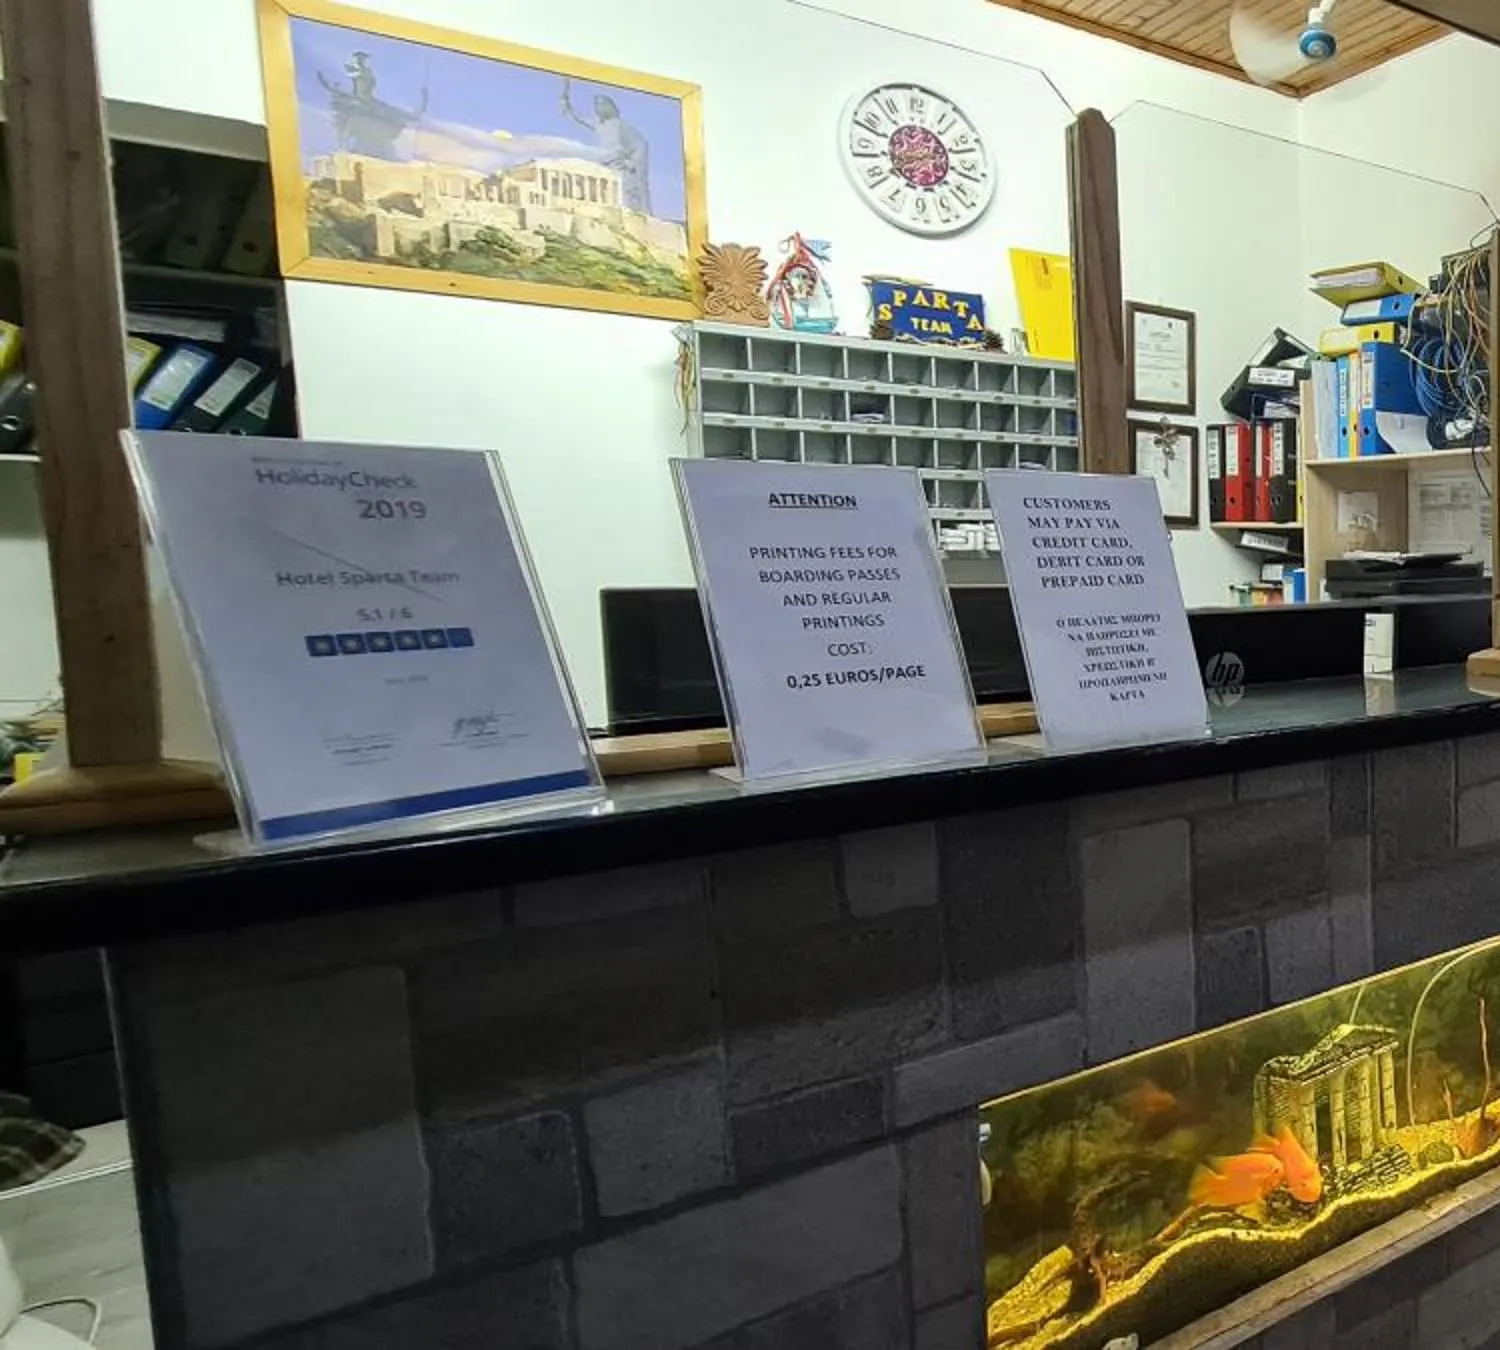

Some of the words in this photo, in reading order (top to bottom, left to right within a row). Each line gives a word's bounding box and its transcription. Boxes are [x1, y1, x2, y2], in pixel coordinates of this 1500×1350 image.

[877, 288, 984, 331] SPARTA
[909, 316, 953, 335] TEAM
[254, 468, 418, 492] HolidayCheck
[768, 492, 859, 509] ATTENTION
[1023, 497, 1112, 511] CUSTOMERS
[355, 499, 428, 520] 2019
[1027, 515, 1061, 529] MAY
[1064, 516, 1092, 529] PAY
[1095, 517, 1121, 529] VIA
[1031, 536, 1087, 549] CREDIT
[1090, 536, 1133, 549] CARD,
[749, 546, 826, 560] PRINTING
[830, 547, 865, 559] FEES
[867, 546, 898, 559] FOR
[1036, 555, 1081, 569] DEBIT
[1085, 555, 1123, 567] CARD
[1125, 555, 1146, 567] OR
[275, 570, 334, 587] Hotel
[338, 570, 404, 588] Sparta
[408, 569, 462, 585] Team
[759, 569, 845, 584] BOARDING
[847, 567, 901, 581] PASSES
[1041, 575, 1105, 589] PREPAID
[1107, 573, 1145, 586] CARD
[783, 593, 818, 608] AND
[821, 591, 893, 606] REGULAR
[801, 613, 886, 630] PRINTINGS
[827, 641, 873, 657] COST:
[786, 672, 822, 690] 0,25
[825, 664, 927, 685] EUROS/PAGE
